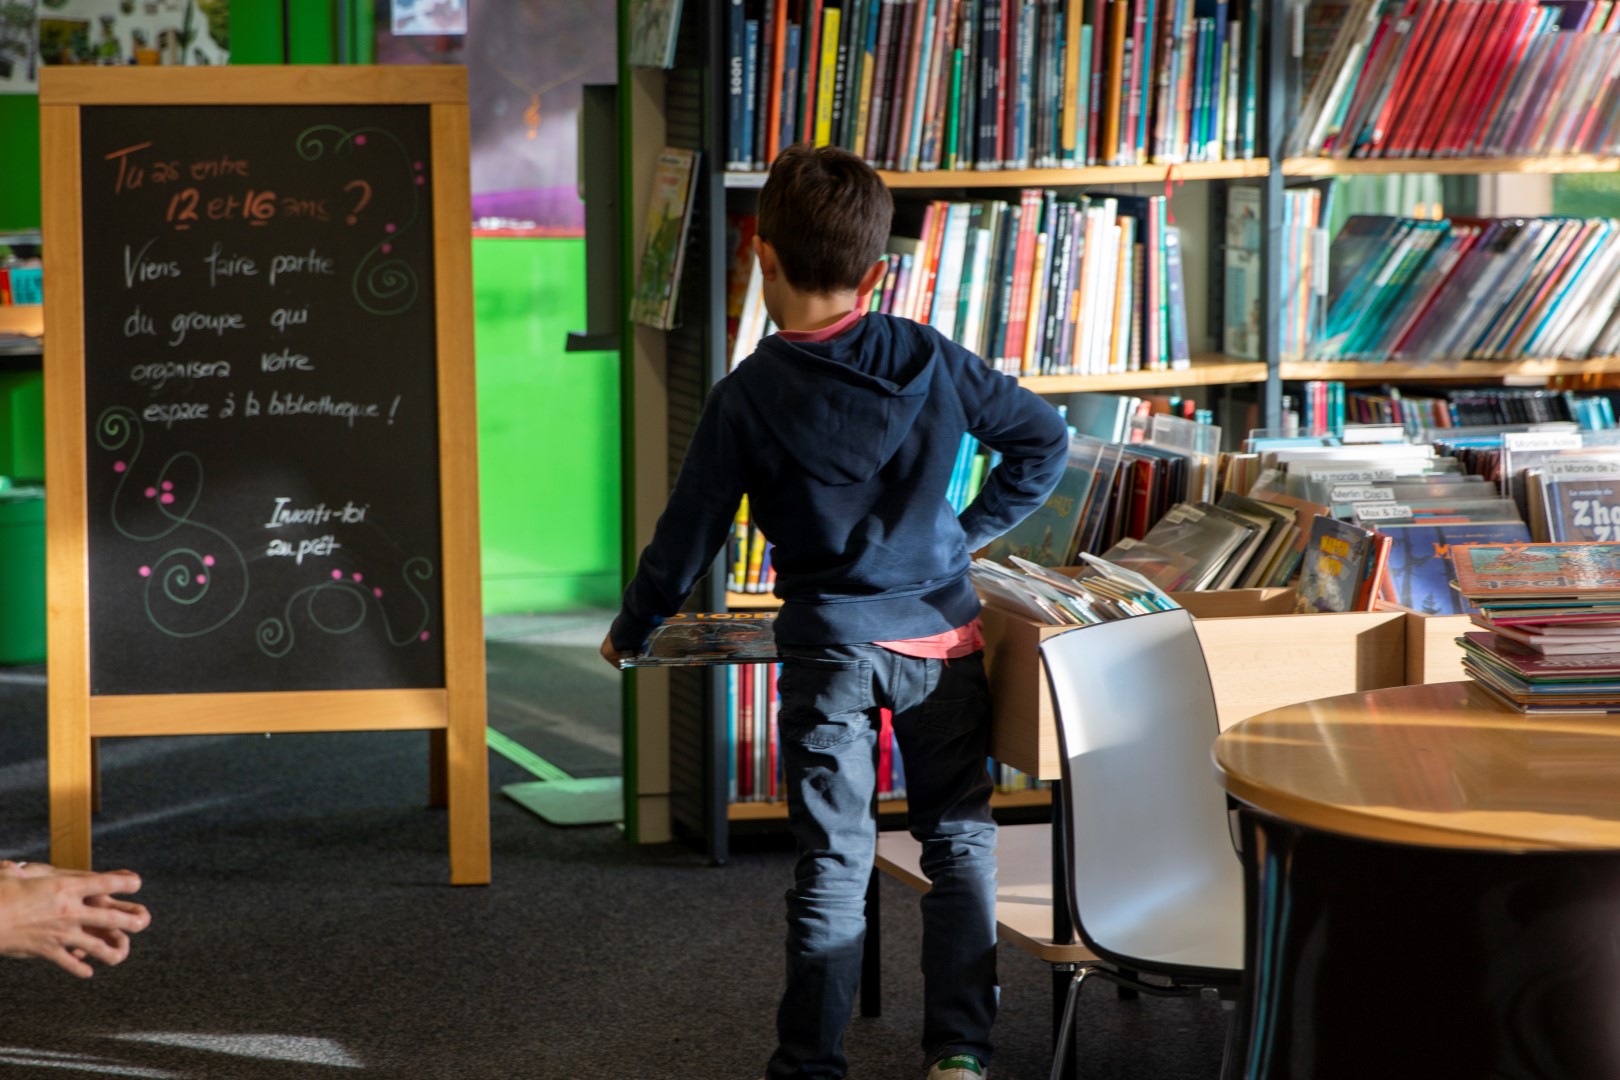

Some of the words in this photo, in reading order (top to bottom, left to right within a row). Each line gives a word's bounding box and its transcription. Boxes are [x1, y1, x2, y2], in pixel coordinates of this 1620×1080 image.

[105, 141, 152, 195] Tu
[151, 160, 181, 183] as
[190, 154, 250, 181] entre
[166, 188, 199, 223] 12
[207, 195, 236, 220] et
[242, 190, 277, 220] 16
[282, 199, 331, 222] ans
[124, 236, 182, 289] Viens
[204, 241, 260, 288] faire
[269, 248, 335, 287] partie
[123, 305, 156, 338] du
[169, 310, 246, 347] groupe
[270, 304, 309, 333] qui
[130, 361, 231, 391] organisera
[143, 402, 209, 430] espace
[1551, 464, 1563, 474] Le
[1564, 463, 1595, 474] Monde
